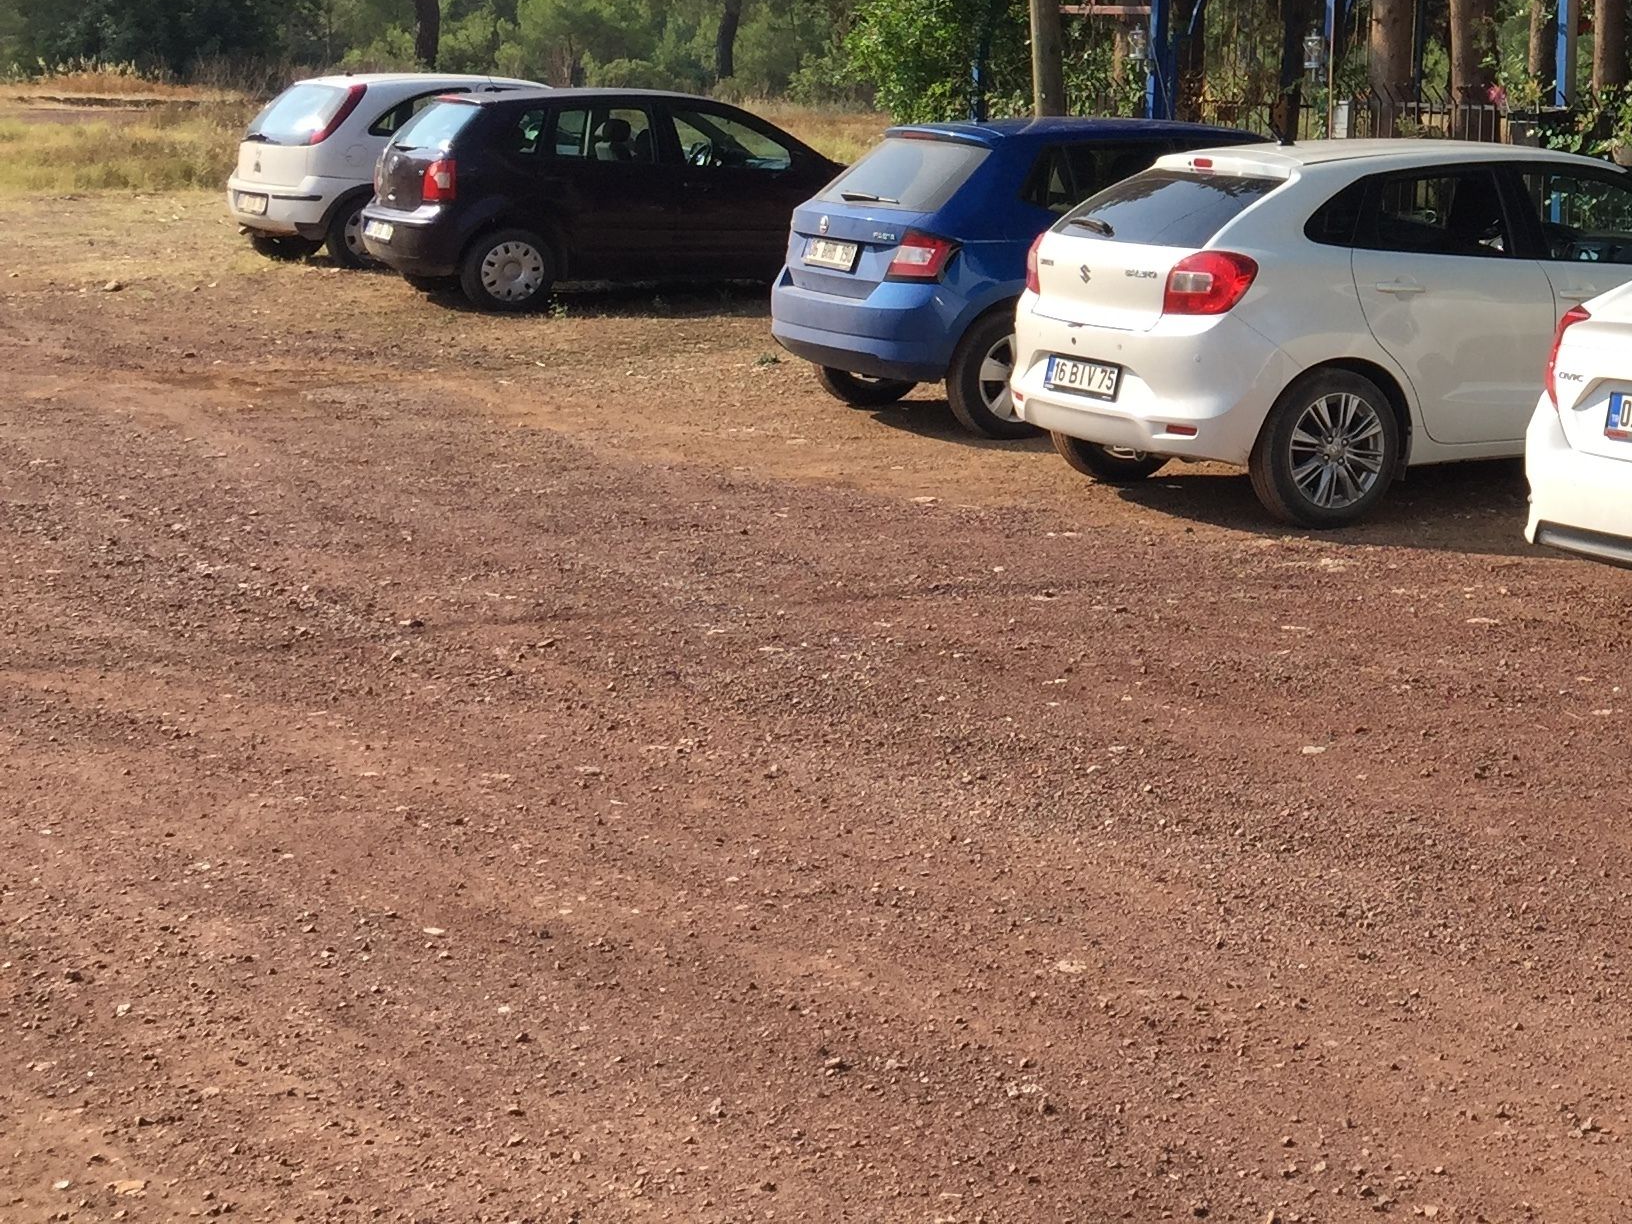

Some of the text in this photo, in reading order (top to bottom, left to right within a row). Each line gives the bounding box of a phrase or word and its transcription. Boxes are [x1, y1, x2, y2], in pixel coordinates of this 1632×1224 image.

[1054, 361, 1116, 391] 16 BIV 75
